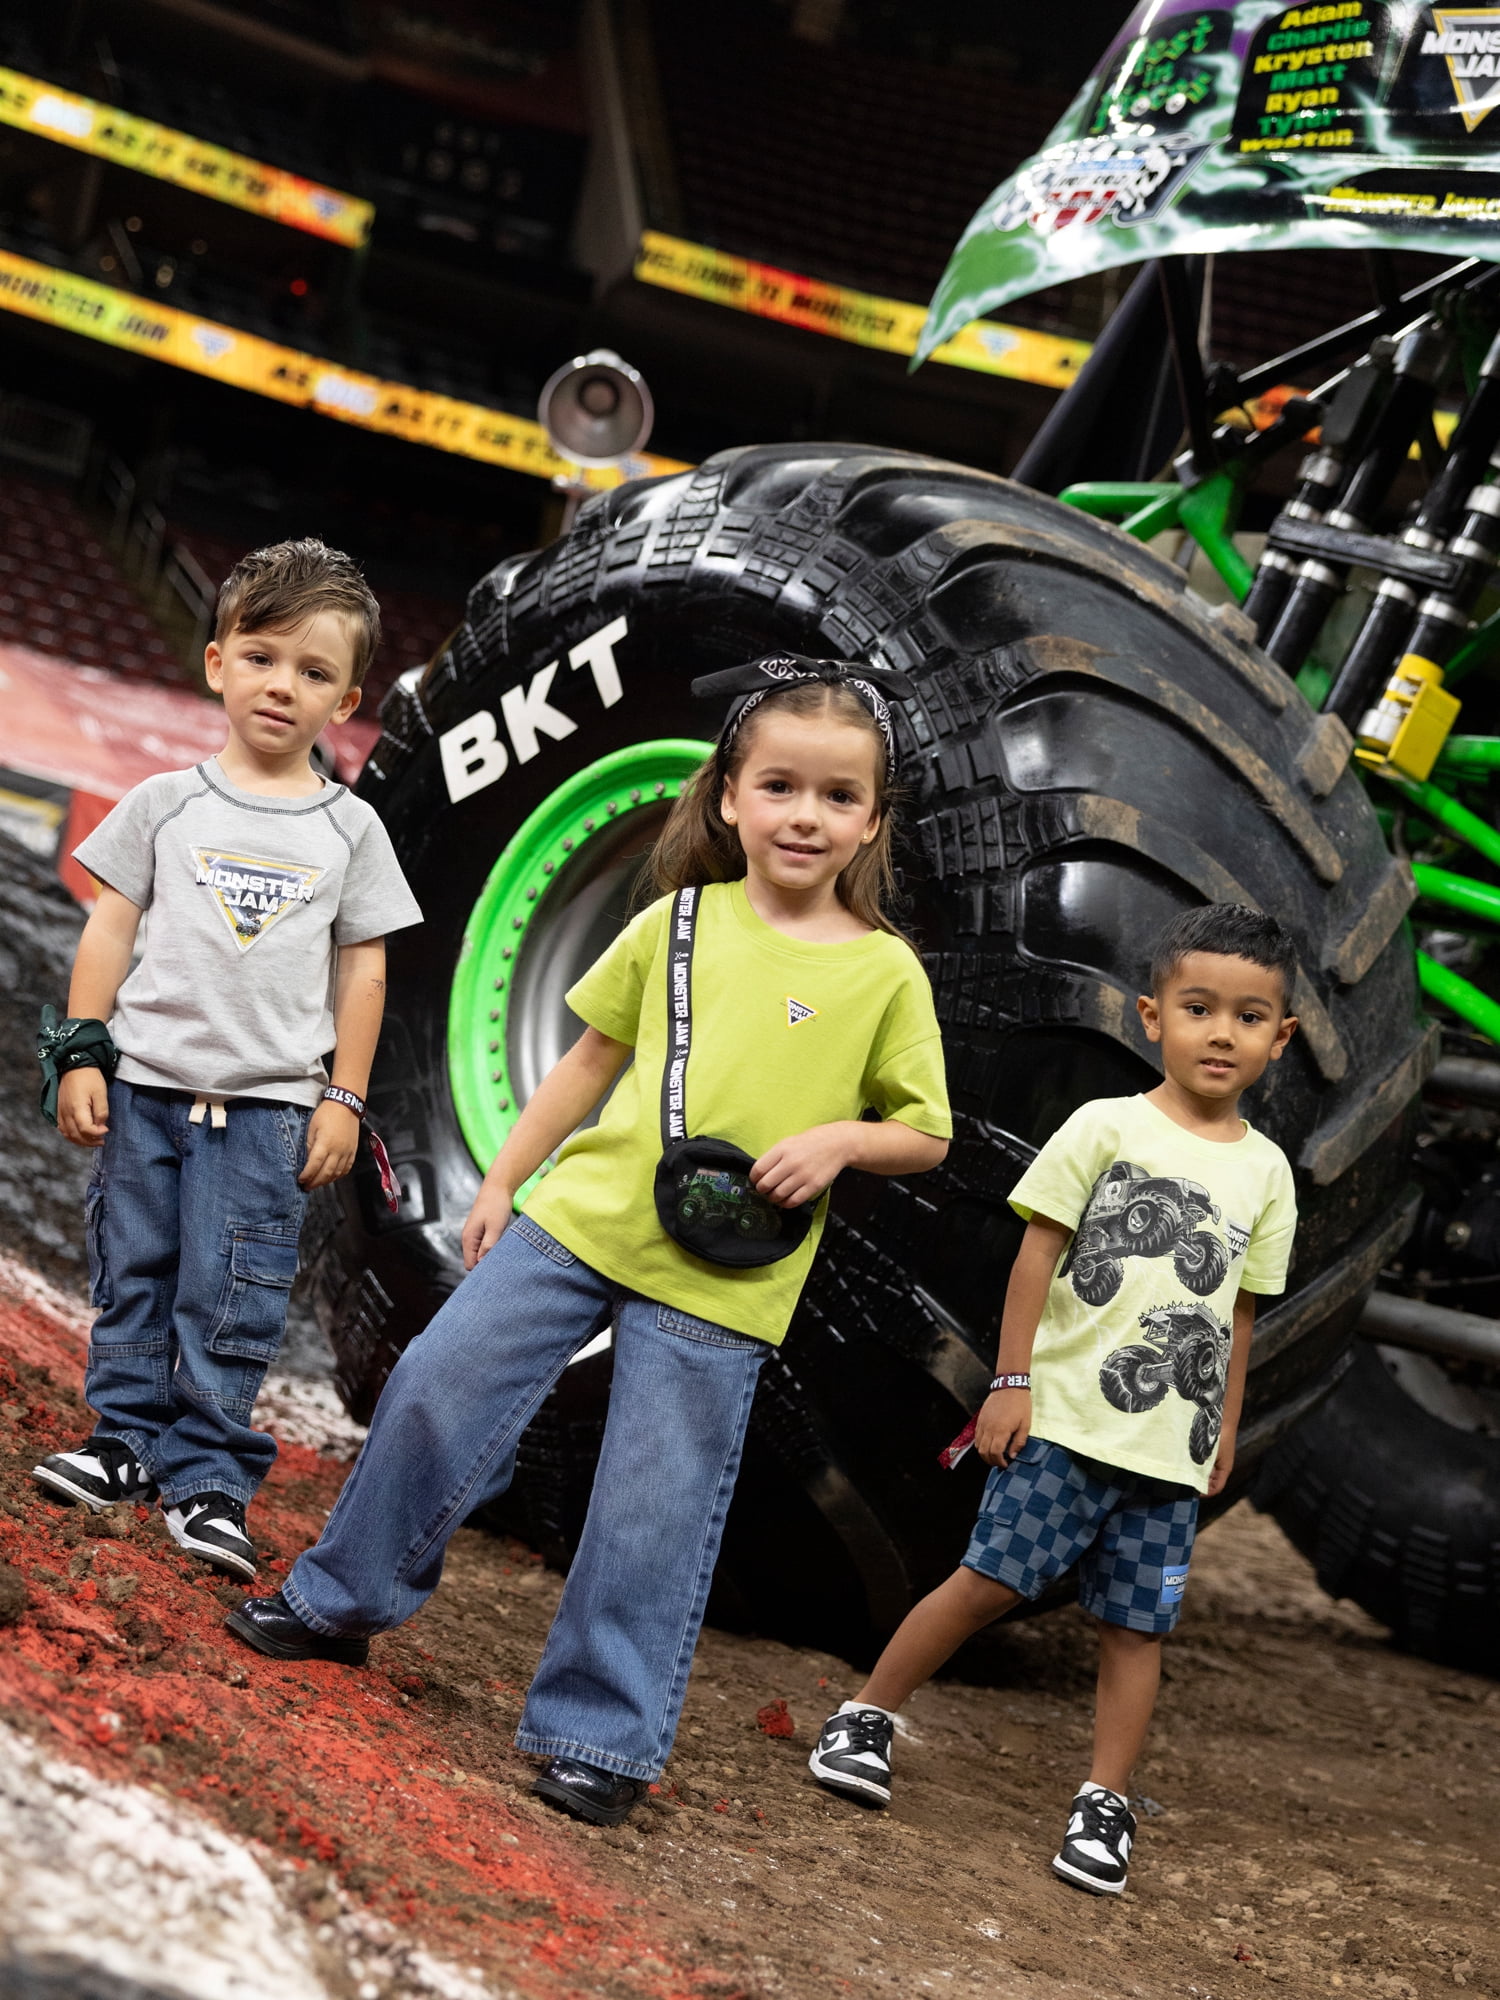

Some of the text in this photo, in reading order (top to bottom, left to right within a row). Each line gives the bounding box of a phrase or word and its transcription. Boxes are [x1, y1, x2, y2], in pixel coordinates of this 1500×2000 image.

[1280, 1, 1362, 30] Adam
[1267, 18, 1371, 51] Charlie
[1253, 40, 1374, 74] Krysten
[1454, 54, 1500, 77] JA
[1270, 63, 1348, 91] Matt
[1265, 87, 1339, 114] Ryan
[1257, 109, 1338, 137] Tyler
[439, 615, 629, 805] BKT
[196, 867, 316, 904] MONSTER
[223, 889, 280, 914] JAM
[673, 962, 689, 1047] MONSTER JAM
[669, 1058, 686, 1139] MONSTER JAM
